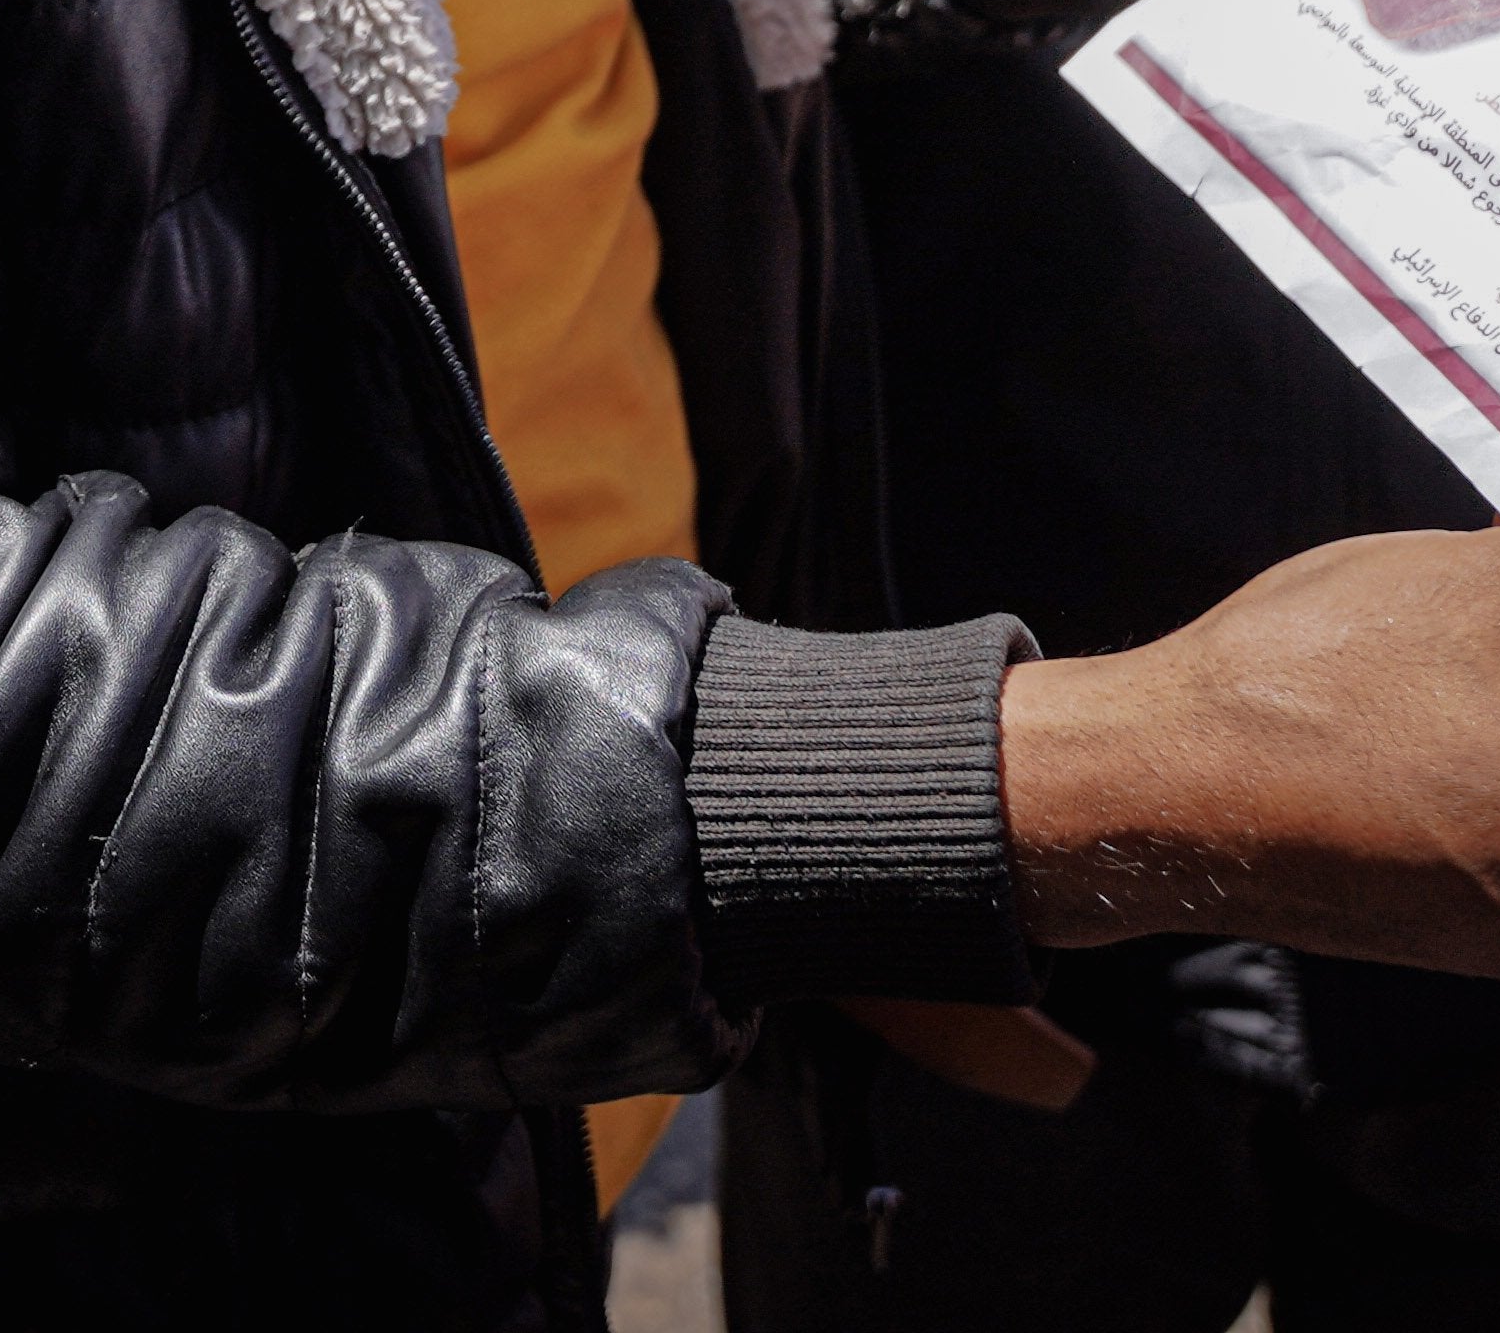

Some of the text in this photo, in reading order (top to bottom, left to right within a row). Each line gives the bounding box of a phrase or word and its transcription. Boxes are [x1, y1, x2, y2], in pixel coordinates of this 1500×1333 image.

[1391, 73, 1447, 125] الإنسانية
[1383, 109, 1419, 141] وادي
[1414, 135, 1440, 158] من
[1440, 117, 1496, 172] المنطقة
[1438, 150, 1478, 191] شمالا
[1388, 246, 1463, 302] الإسرائيلي
